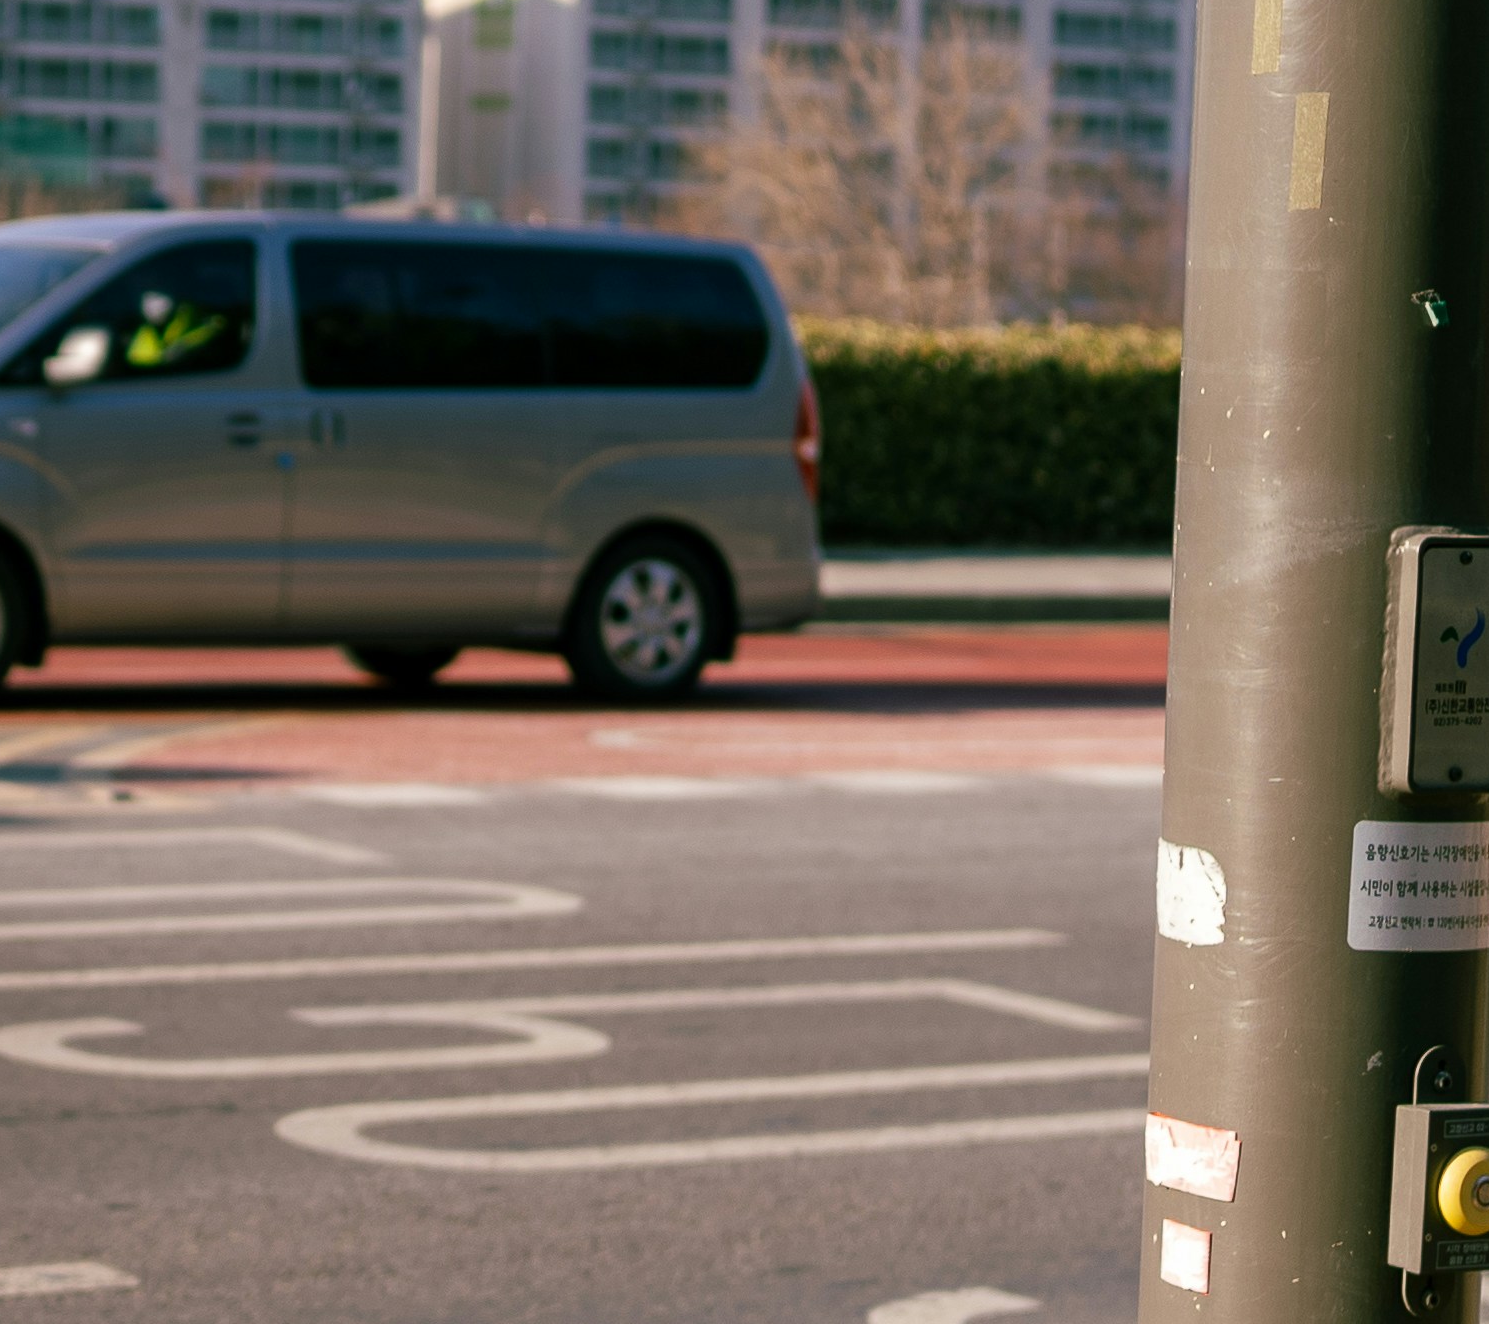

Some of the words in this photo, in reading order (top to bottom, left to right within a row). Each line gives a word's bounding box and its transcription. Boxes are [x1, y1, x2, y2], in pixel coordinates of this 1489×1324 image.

[1365, 844, 1430, 863] 음향신호기는
[1433, 844, 1479, 863] 시각장애인을
[1360, 879, 1393, 897] 시민이
[1397, 879, 1418, 897] 함께
[1421, 879, 1458, 898] 사용하는
[1368, 916, 1398, 931] 고장신고
